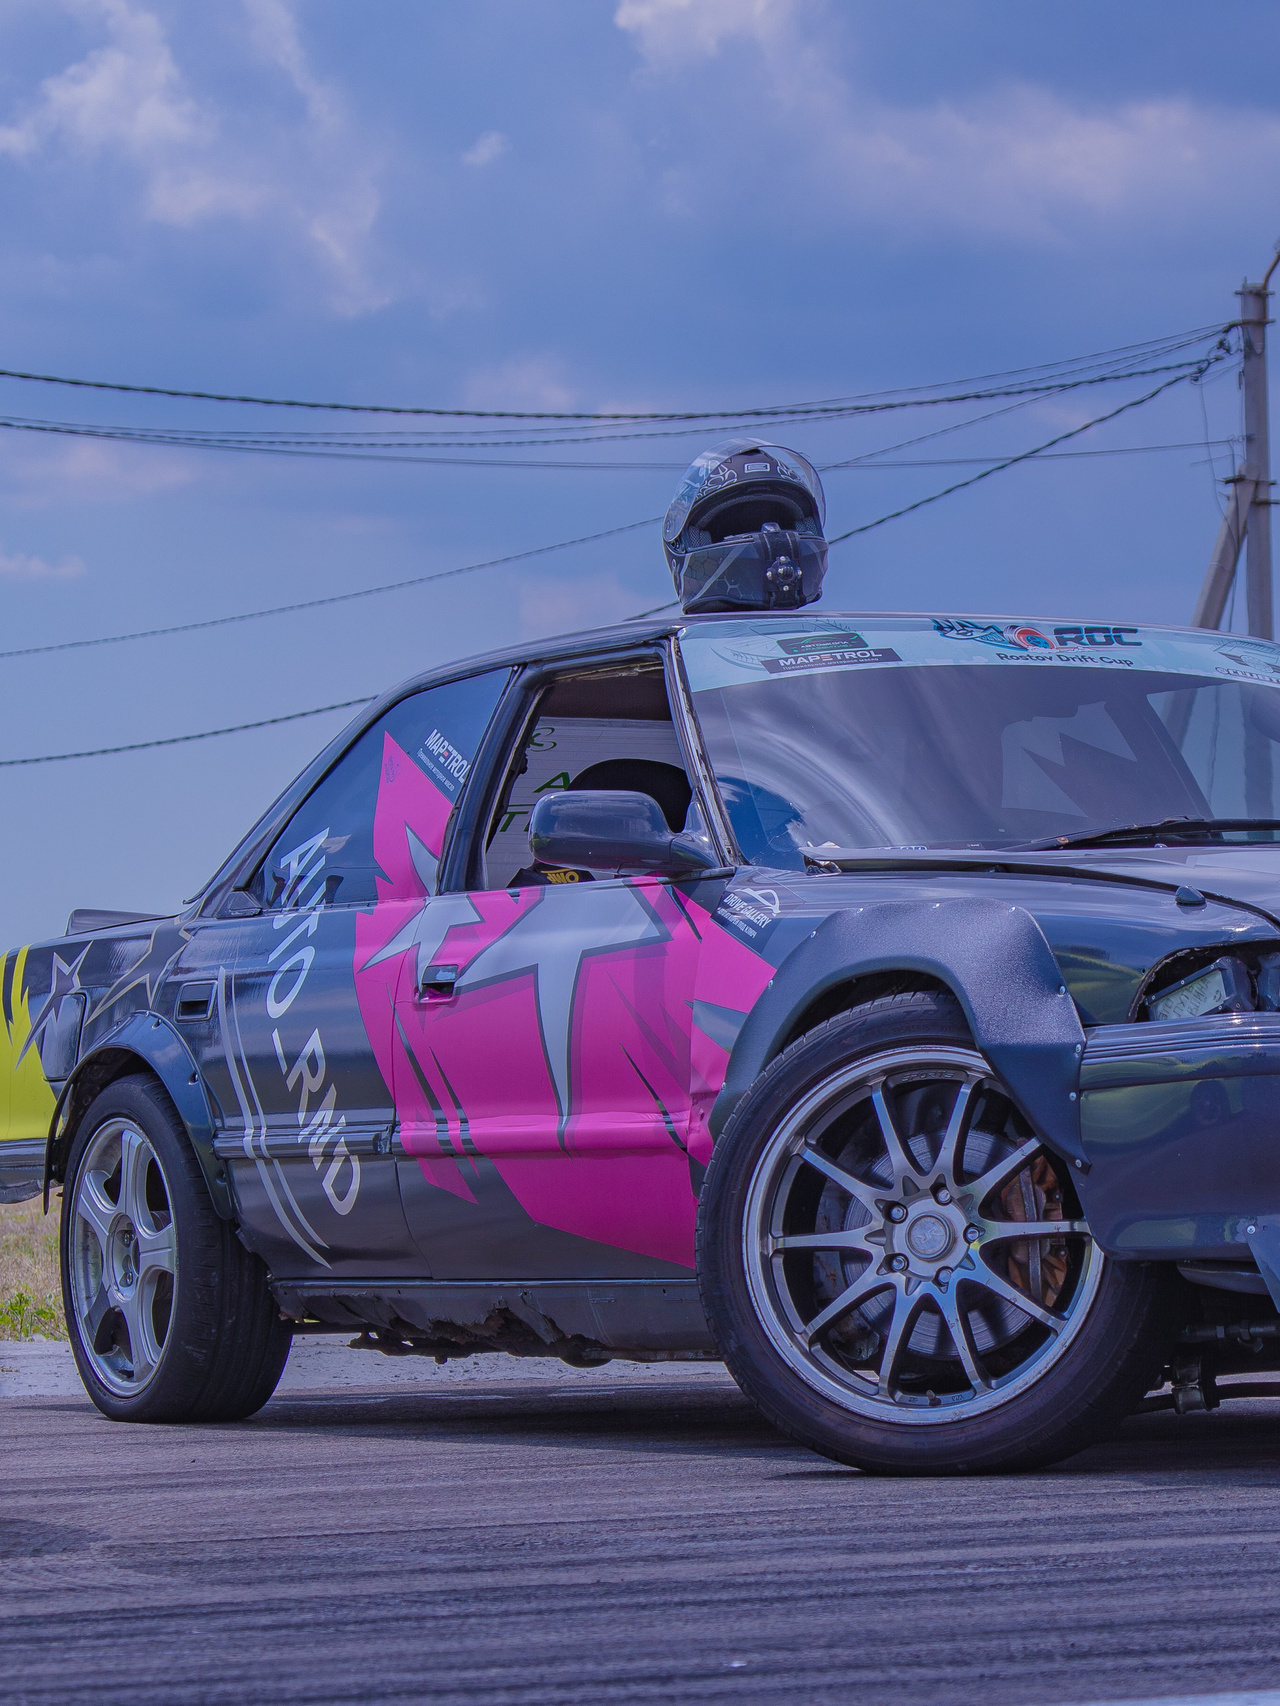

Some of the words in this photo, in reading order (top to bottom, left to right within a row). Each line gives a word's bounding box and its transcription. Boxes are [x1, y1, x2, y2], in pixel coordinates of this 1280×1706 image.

[1054, 627, 1142, 646] RDC
[779, 650, 882, 666] MAPETROL
[996, 652, 1053, 662] Rostov
[1057, 653, 1097, 664] Drift
[1099, 656, 1134, 667] Cup
[424, 729, 471, 783] MAPETROL
[723, 893, 748, 911] DRIVE
[740, 905, 772, 929] GALLERY
